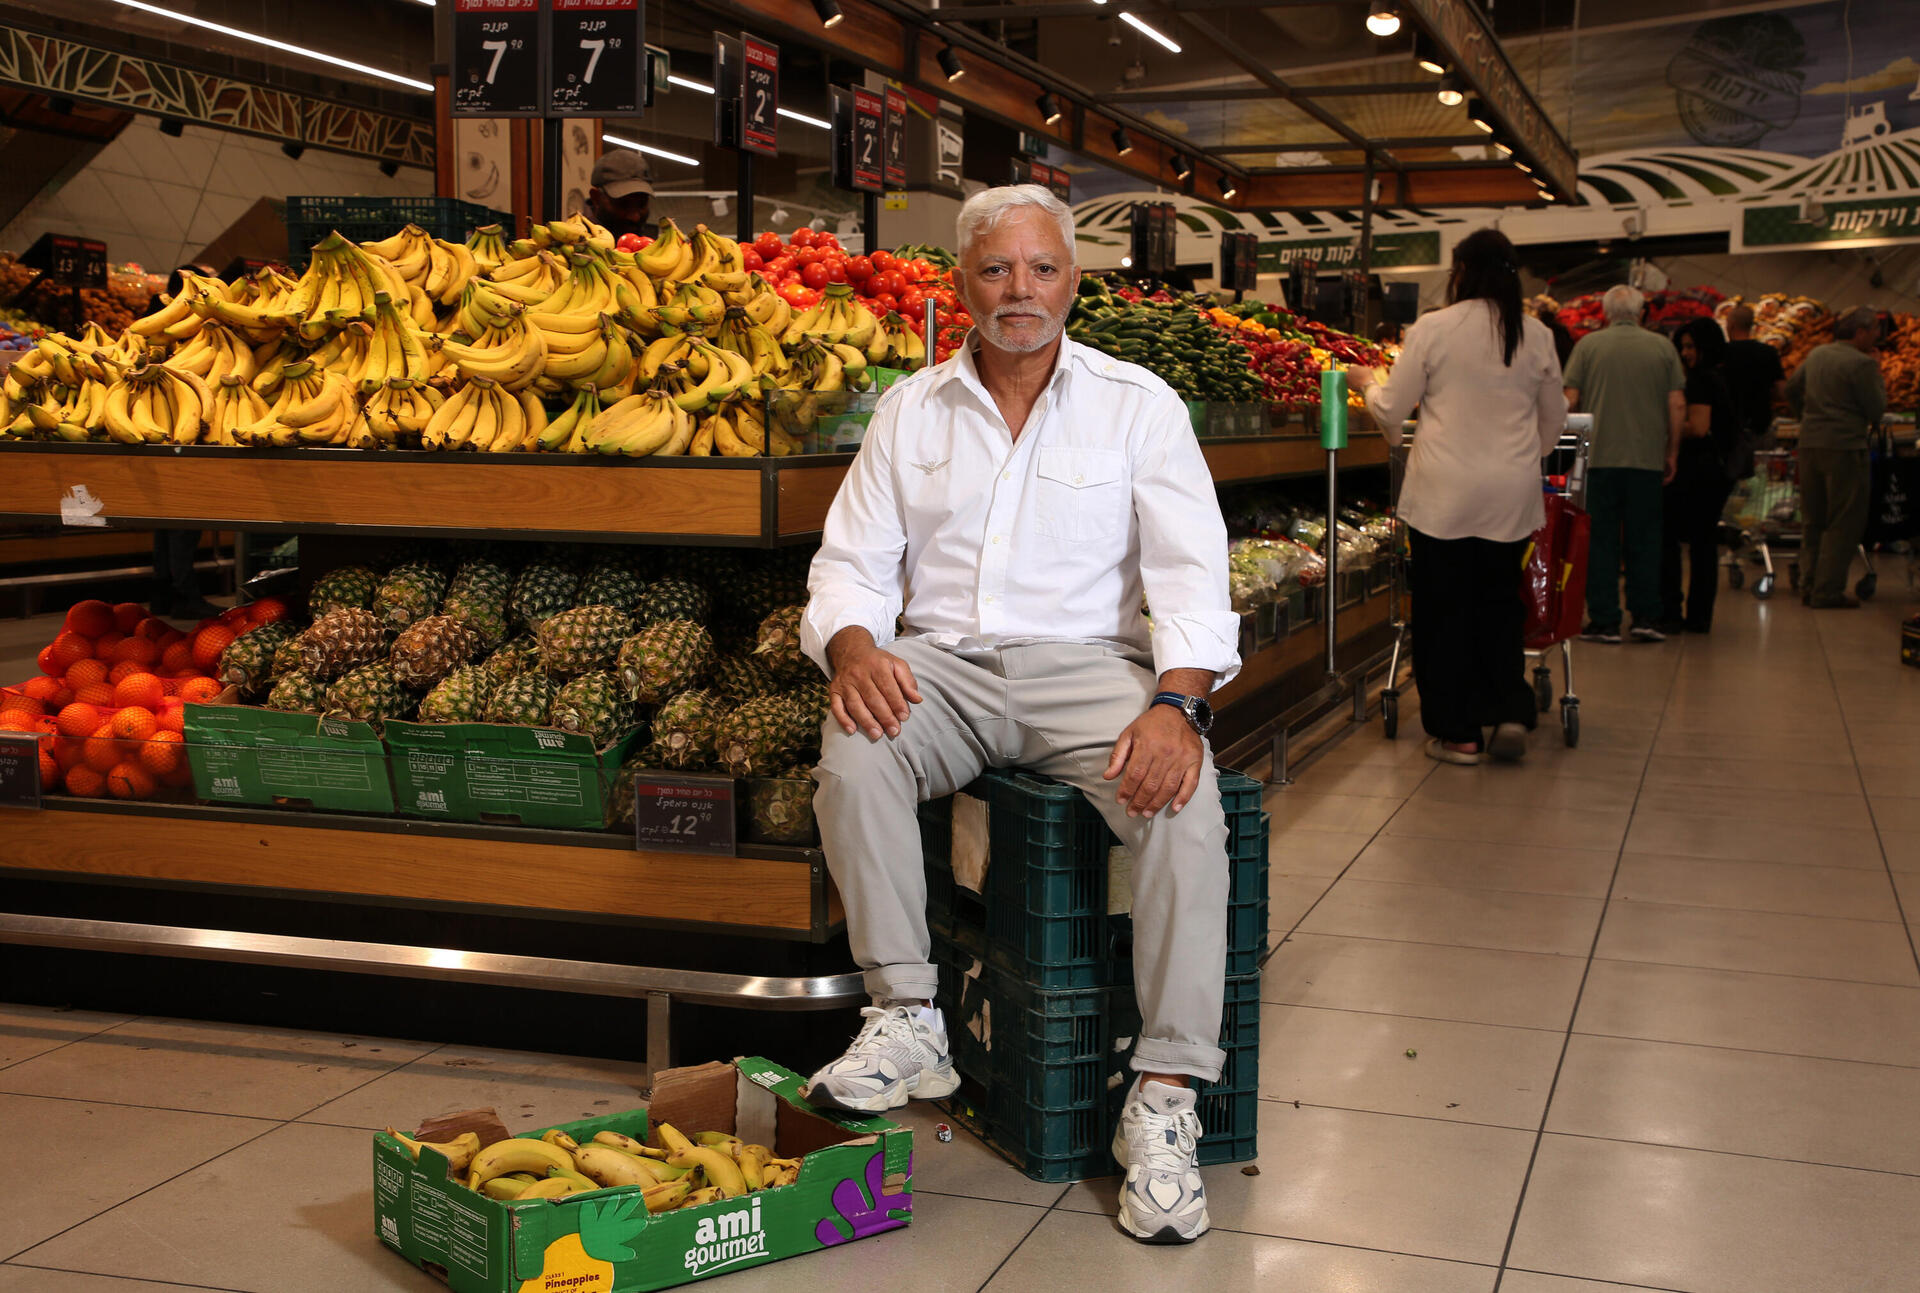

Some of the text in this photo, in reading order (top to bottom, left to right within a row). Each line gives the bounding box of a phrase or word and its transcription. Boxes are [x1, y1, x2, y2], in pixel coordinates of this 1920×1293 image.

[482, 39, 523, 85] 7 90
[579, 38, 621, 84] 7 90
[754, 89, 766, 124] 2
[863, 133, 872, 164] 2
[1829, 207, 1908, 234] וירקות
[537, 738, 566, 750] ami
[213, 776, 239, 788] ami
[418, 789, 445, 802] ami
[669, 814, 698, 835] 12
[761, 1070, 790, 1085] ami
[381, 1214, 398, 1236] ami
[695, 1196, 762, 1246] ami
[684, 1229, 767, 1273] gourmet
